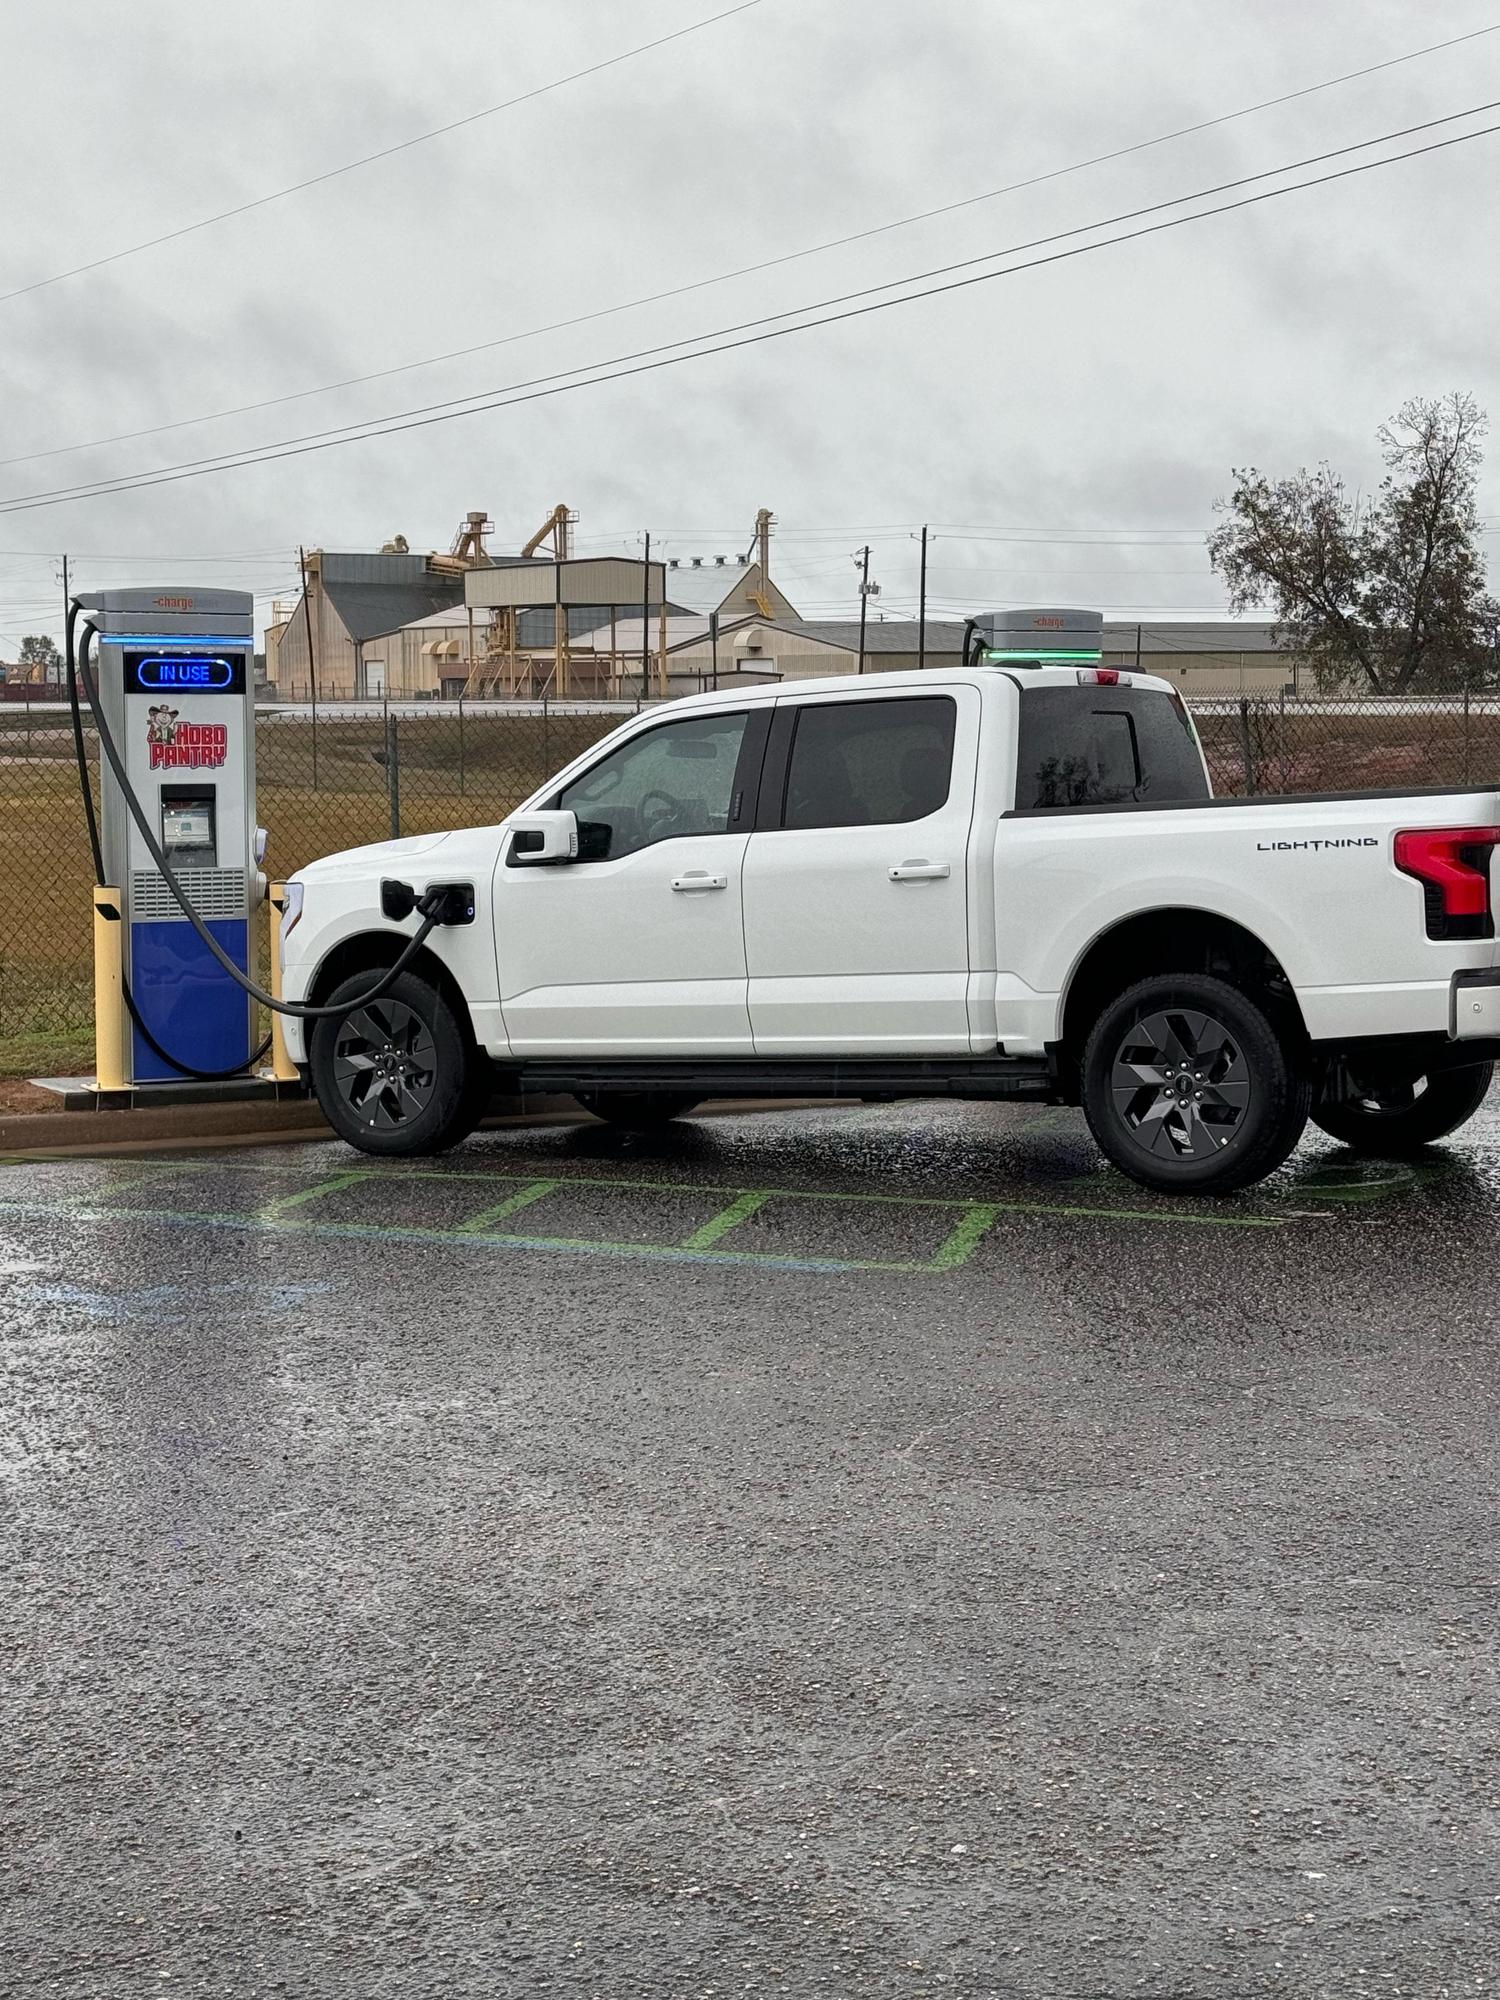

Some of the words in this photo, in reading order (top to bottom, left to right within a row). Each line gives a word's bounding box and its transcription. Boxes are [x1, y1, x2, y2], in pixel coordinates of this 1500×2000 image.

[160, 665, 175, 680] IN
[179, 665, 209, 681] USE
[175, 722, 226, 746] HOBO
[151, 743, 226, 768] PANTRY
[1257, 838, 1379, 851] LIGHTNING
